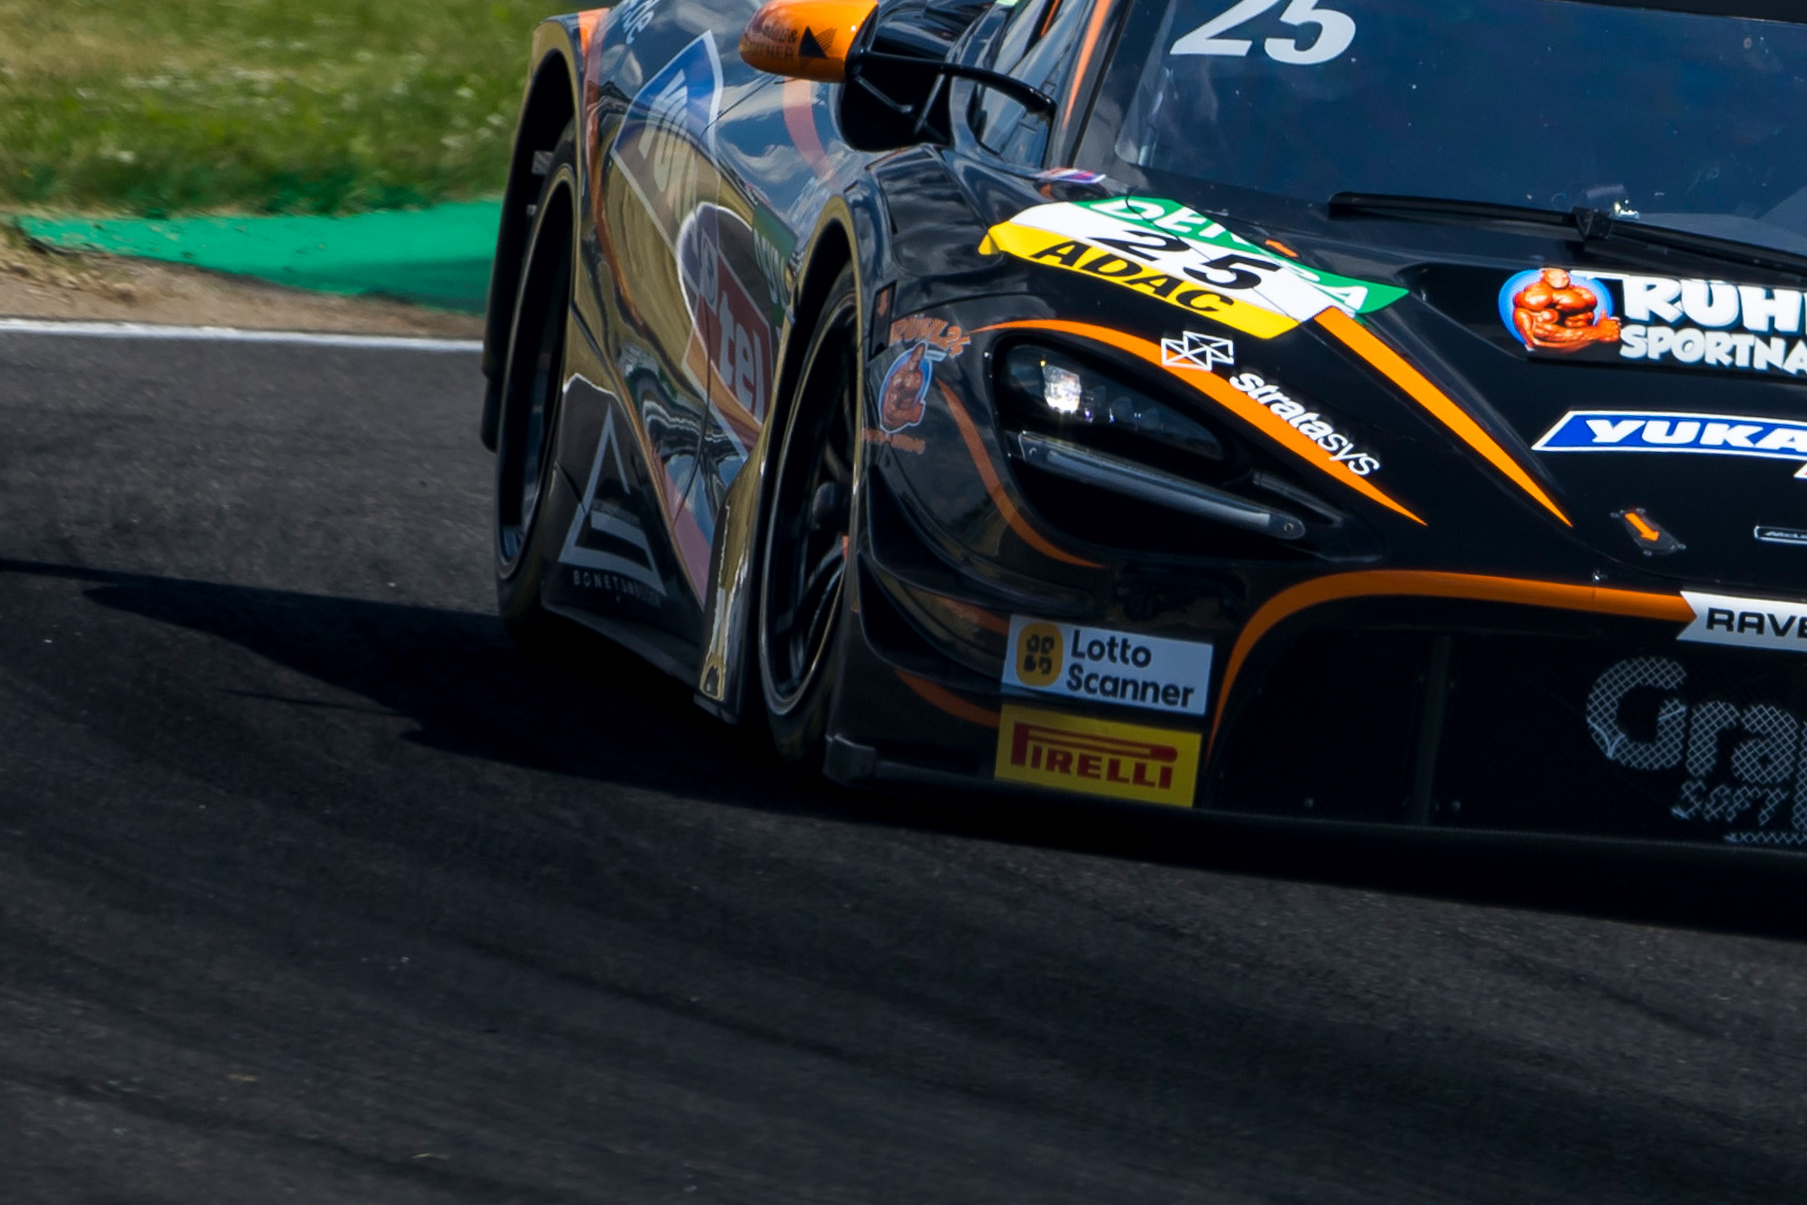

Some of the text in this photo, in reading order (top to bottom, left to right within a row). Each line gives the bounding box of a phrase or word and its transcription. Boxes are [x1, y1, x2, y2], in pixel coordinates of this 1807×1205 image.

[1030, 239, 1235, 313] ADAC
[1084, 229, 1283, 290] 25
[1228, 370, 1381, 477] stratasys
[1070, 628, 1153, 669] Lotto
[1065, 662, 1195, 708] Scanner
[1009, 721, 1179, 790] PIRELLI
